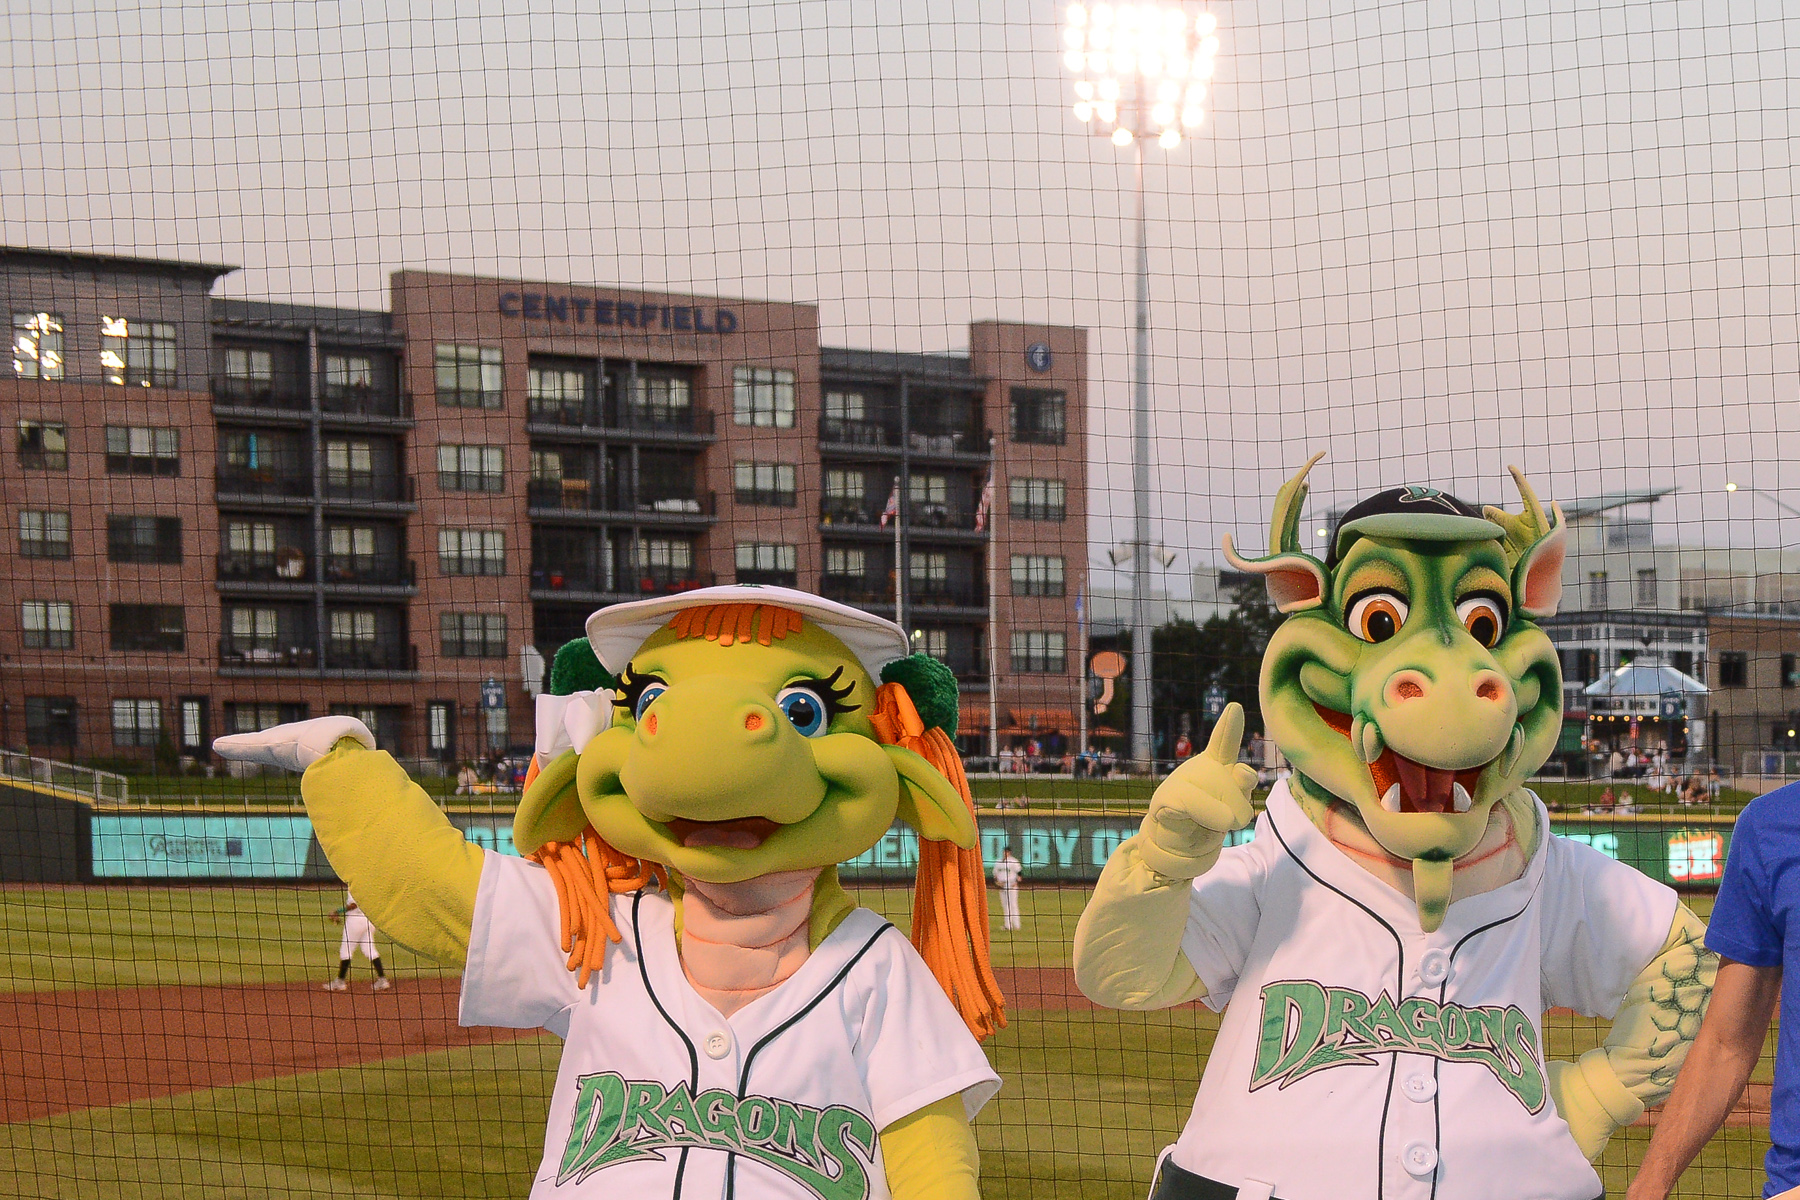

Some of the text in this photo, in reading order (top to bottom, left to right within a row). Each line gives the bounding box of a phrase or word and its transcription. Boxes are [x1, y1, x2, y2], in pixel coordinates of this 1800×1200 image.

[499, 292, 737, 333] CENTERFIELD
[1023, 828, 1080, 868] BY
[1249, 979, 1546, 1115] DRAGONS
